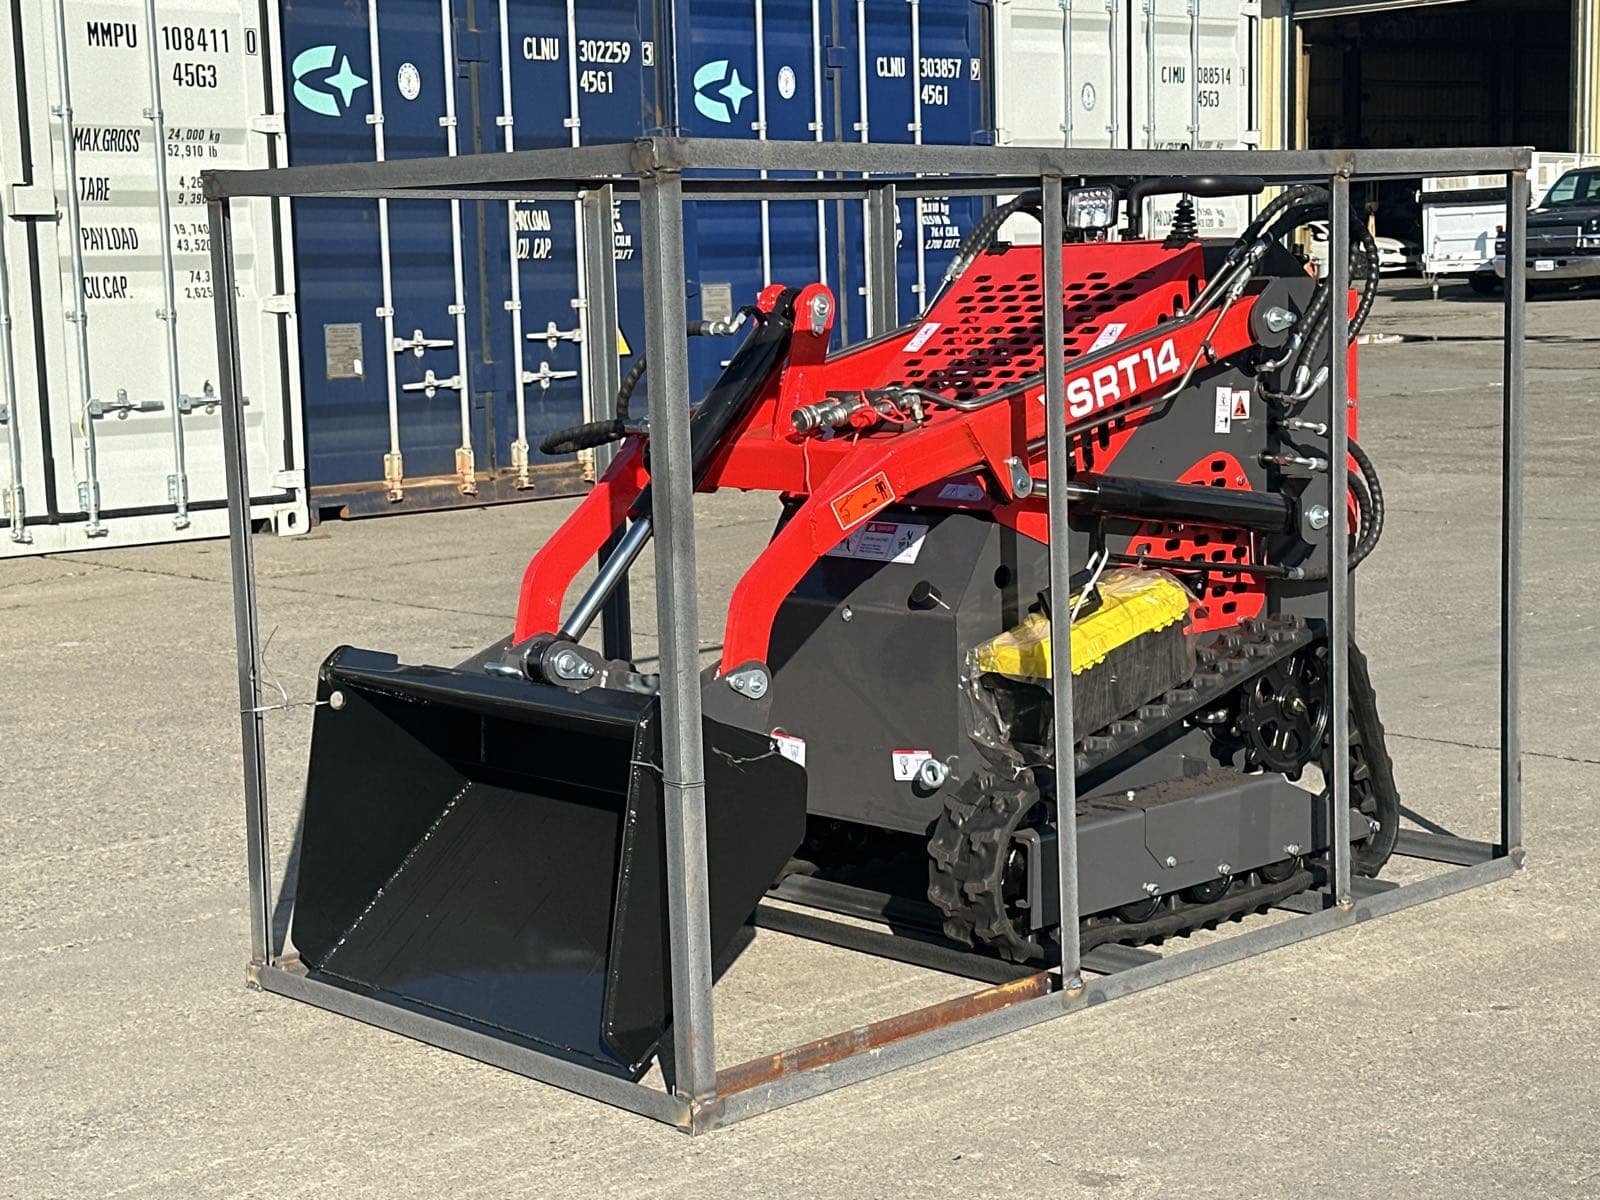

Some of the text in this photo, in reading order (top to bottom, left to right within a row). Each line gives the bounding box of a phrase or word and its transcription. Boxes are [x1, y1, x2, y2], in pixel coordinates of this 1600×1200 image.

[87, 21, 257, 54] MMPU 108411 0
[523, 36, 653, 65] CLNU 302259 3
[173, 62, 217, 88] 45G3
[876, 57, 980, 79] CLNU 303857 9
[1161, 66, 1185, 84] CIMU
[1197, 67, 1231, 85] 088514
[580, 70, 613, 93] 45G1
[921, 84, 949, 106] 45G1
[1197, 90, 1220, 107] 45G3
[168, 128, 205, 141] 24,000
[209, 129, 221, 144] kg
[168, 144, 218, 158] 52,910 lb
[79, 176, 204, 201] TARE 4,26
[81, 227, 138, 250] PAYLOAD
[1038, 338, 1181, 418] SRT14
